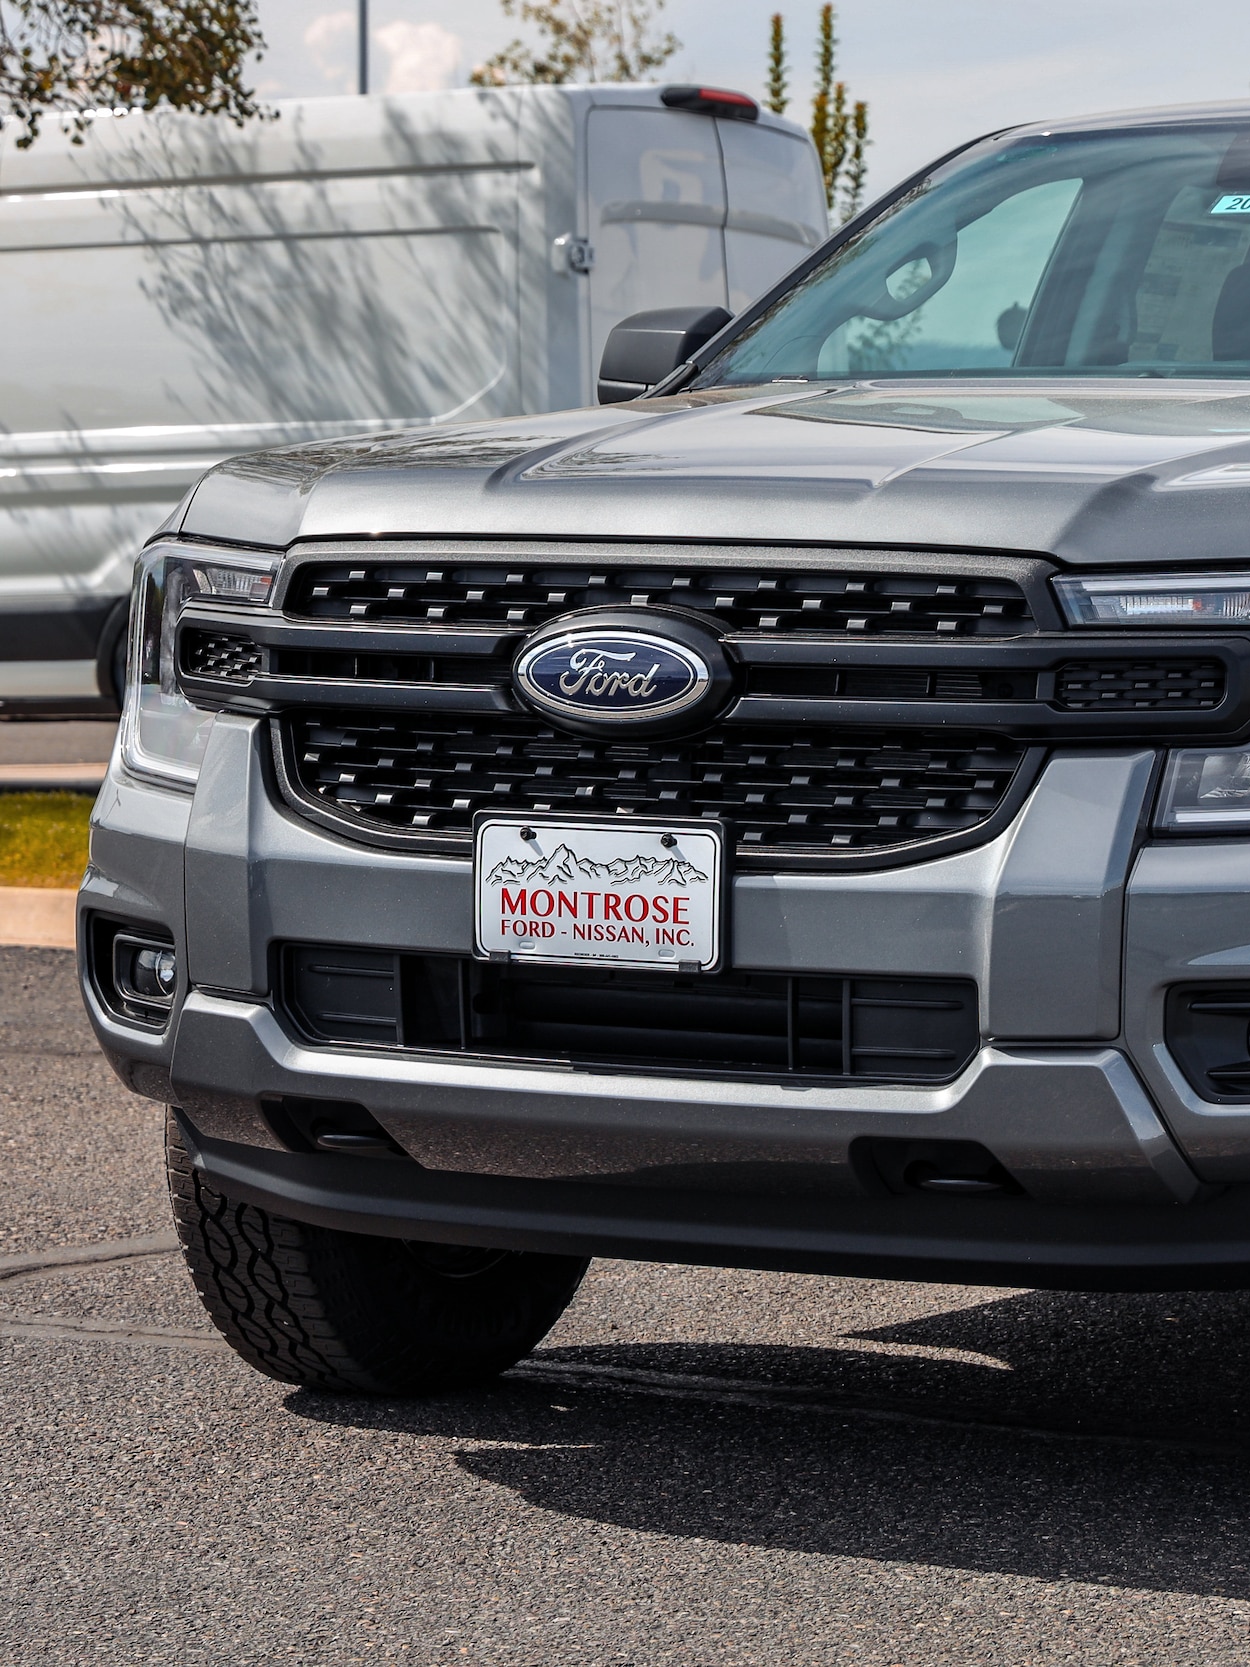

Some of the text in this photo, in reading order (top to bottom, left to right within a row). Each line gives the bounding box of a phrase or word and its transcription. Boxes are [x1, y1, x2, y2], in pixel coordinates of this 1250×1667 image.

[559, 649, 661, 697] Ford
[501, 887, 690, 926] MONTROSE
[501, 919, 555, 939] FORD
[573, 924, 650, 948] NISSAN,
[656, 929, 695, 947] INC.
